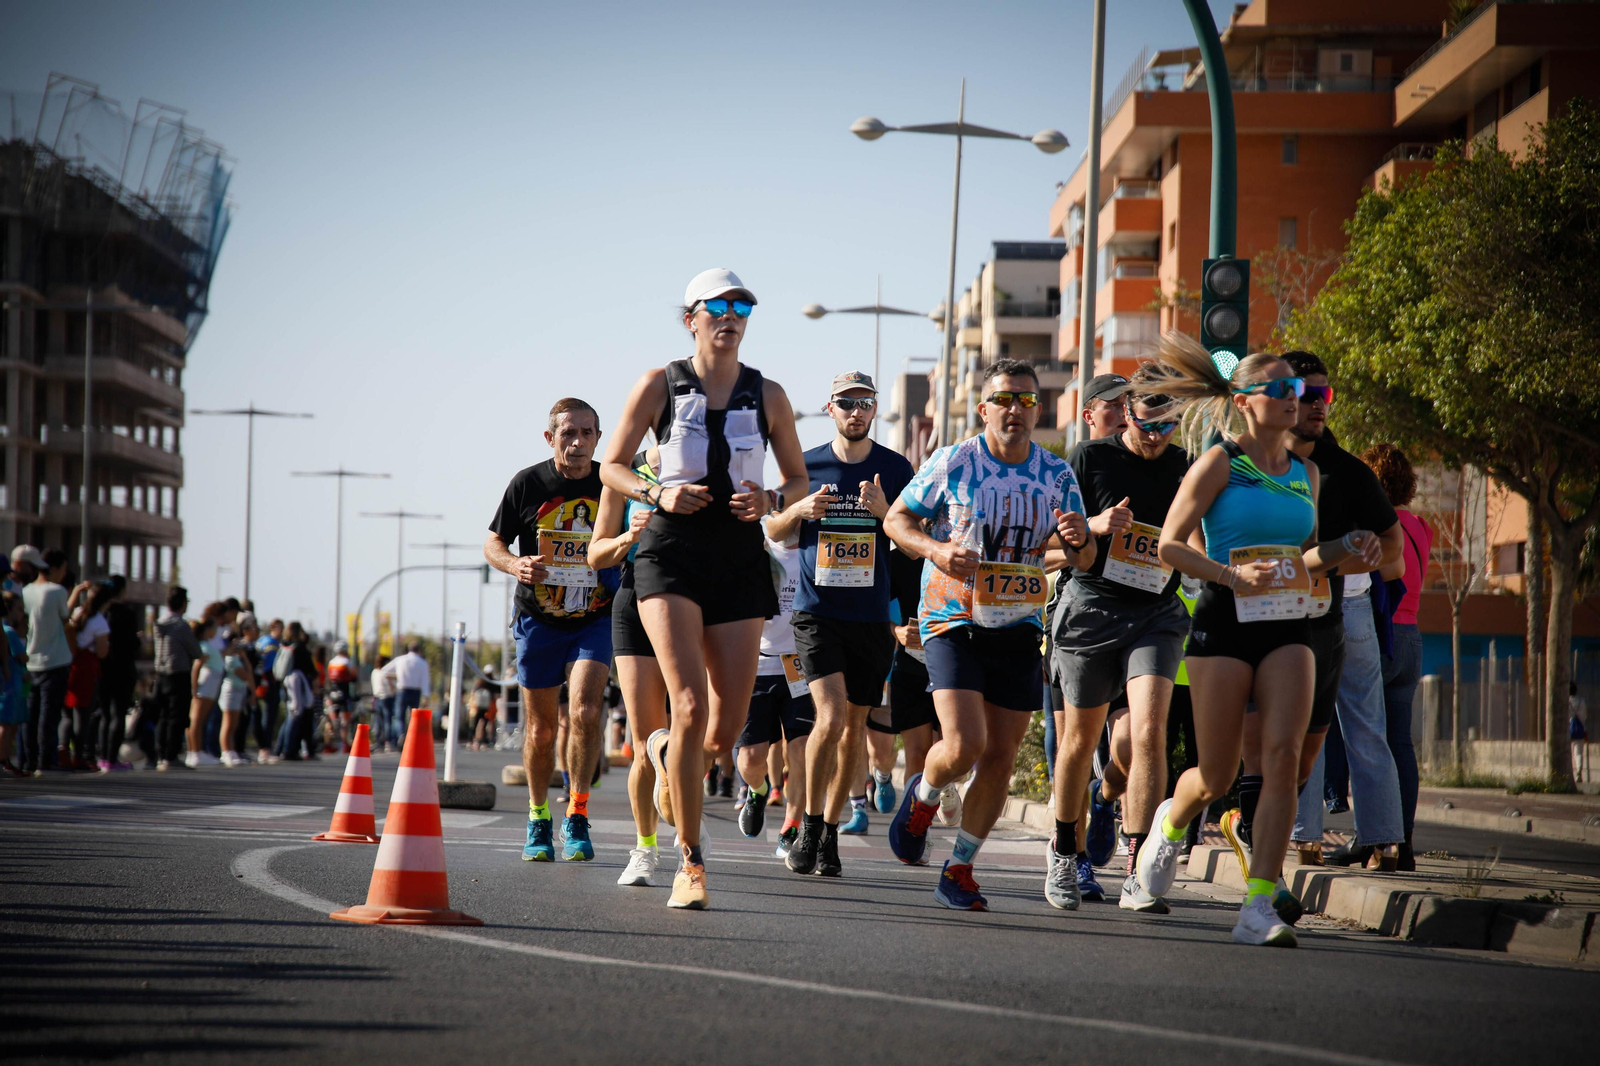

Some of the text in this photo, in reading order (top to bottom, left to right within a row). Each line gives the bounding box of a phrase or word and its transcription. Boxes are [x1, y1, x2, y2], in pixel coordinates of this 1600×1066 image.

[551, 540, 588, 558] 784
[825, 541, 870, 559] 1648
[1122, 531, 1160, 558] 165
[1128, 552, 1144, 561] JUAN
[984, 574, 1042, 595] 1738
